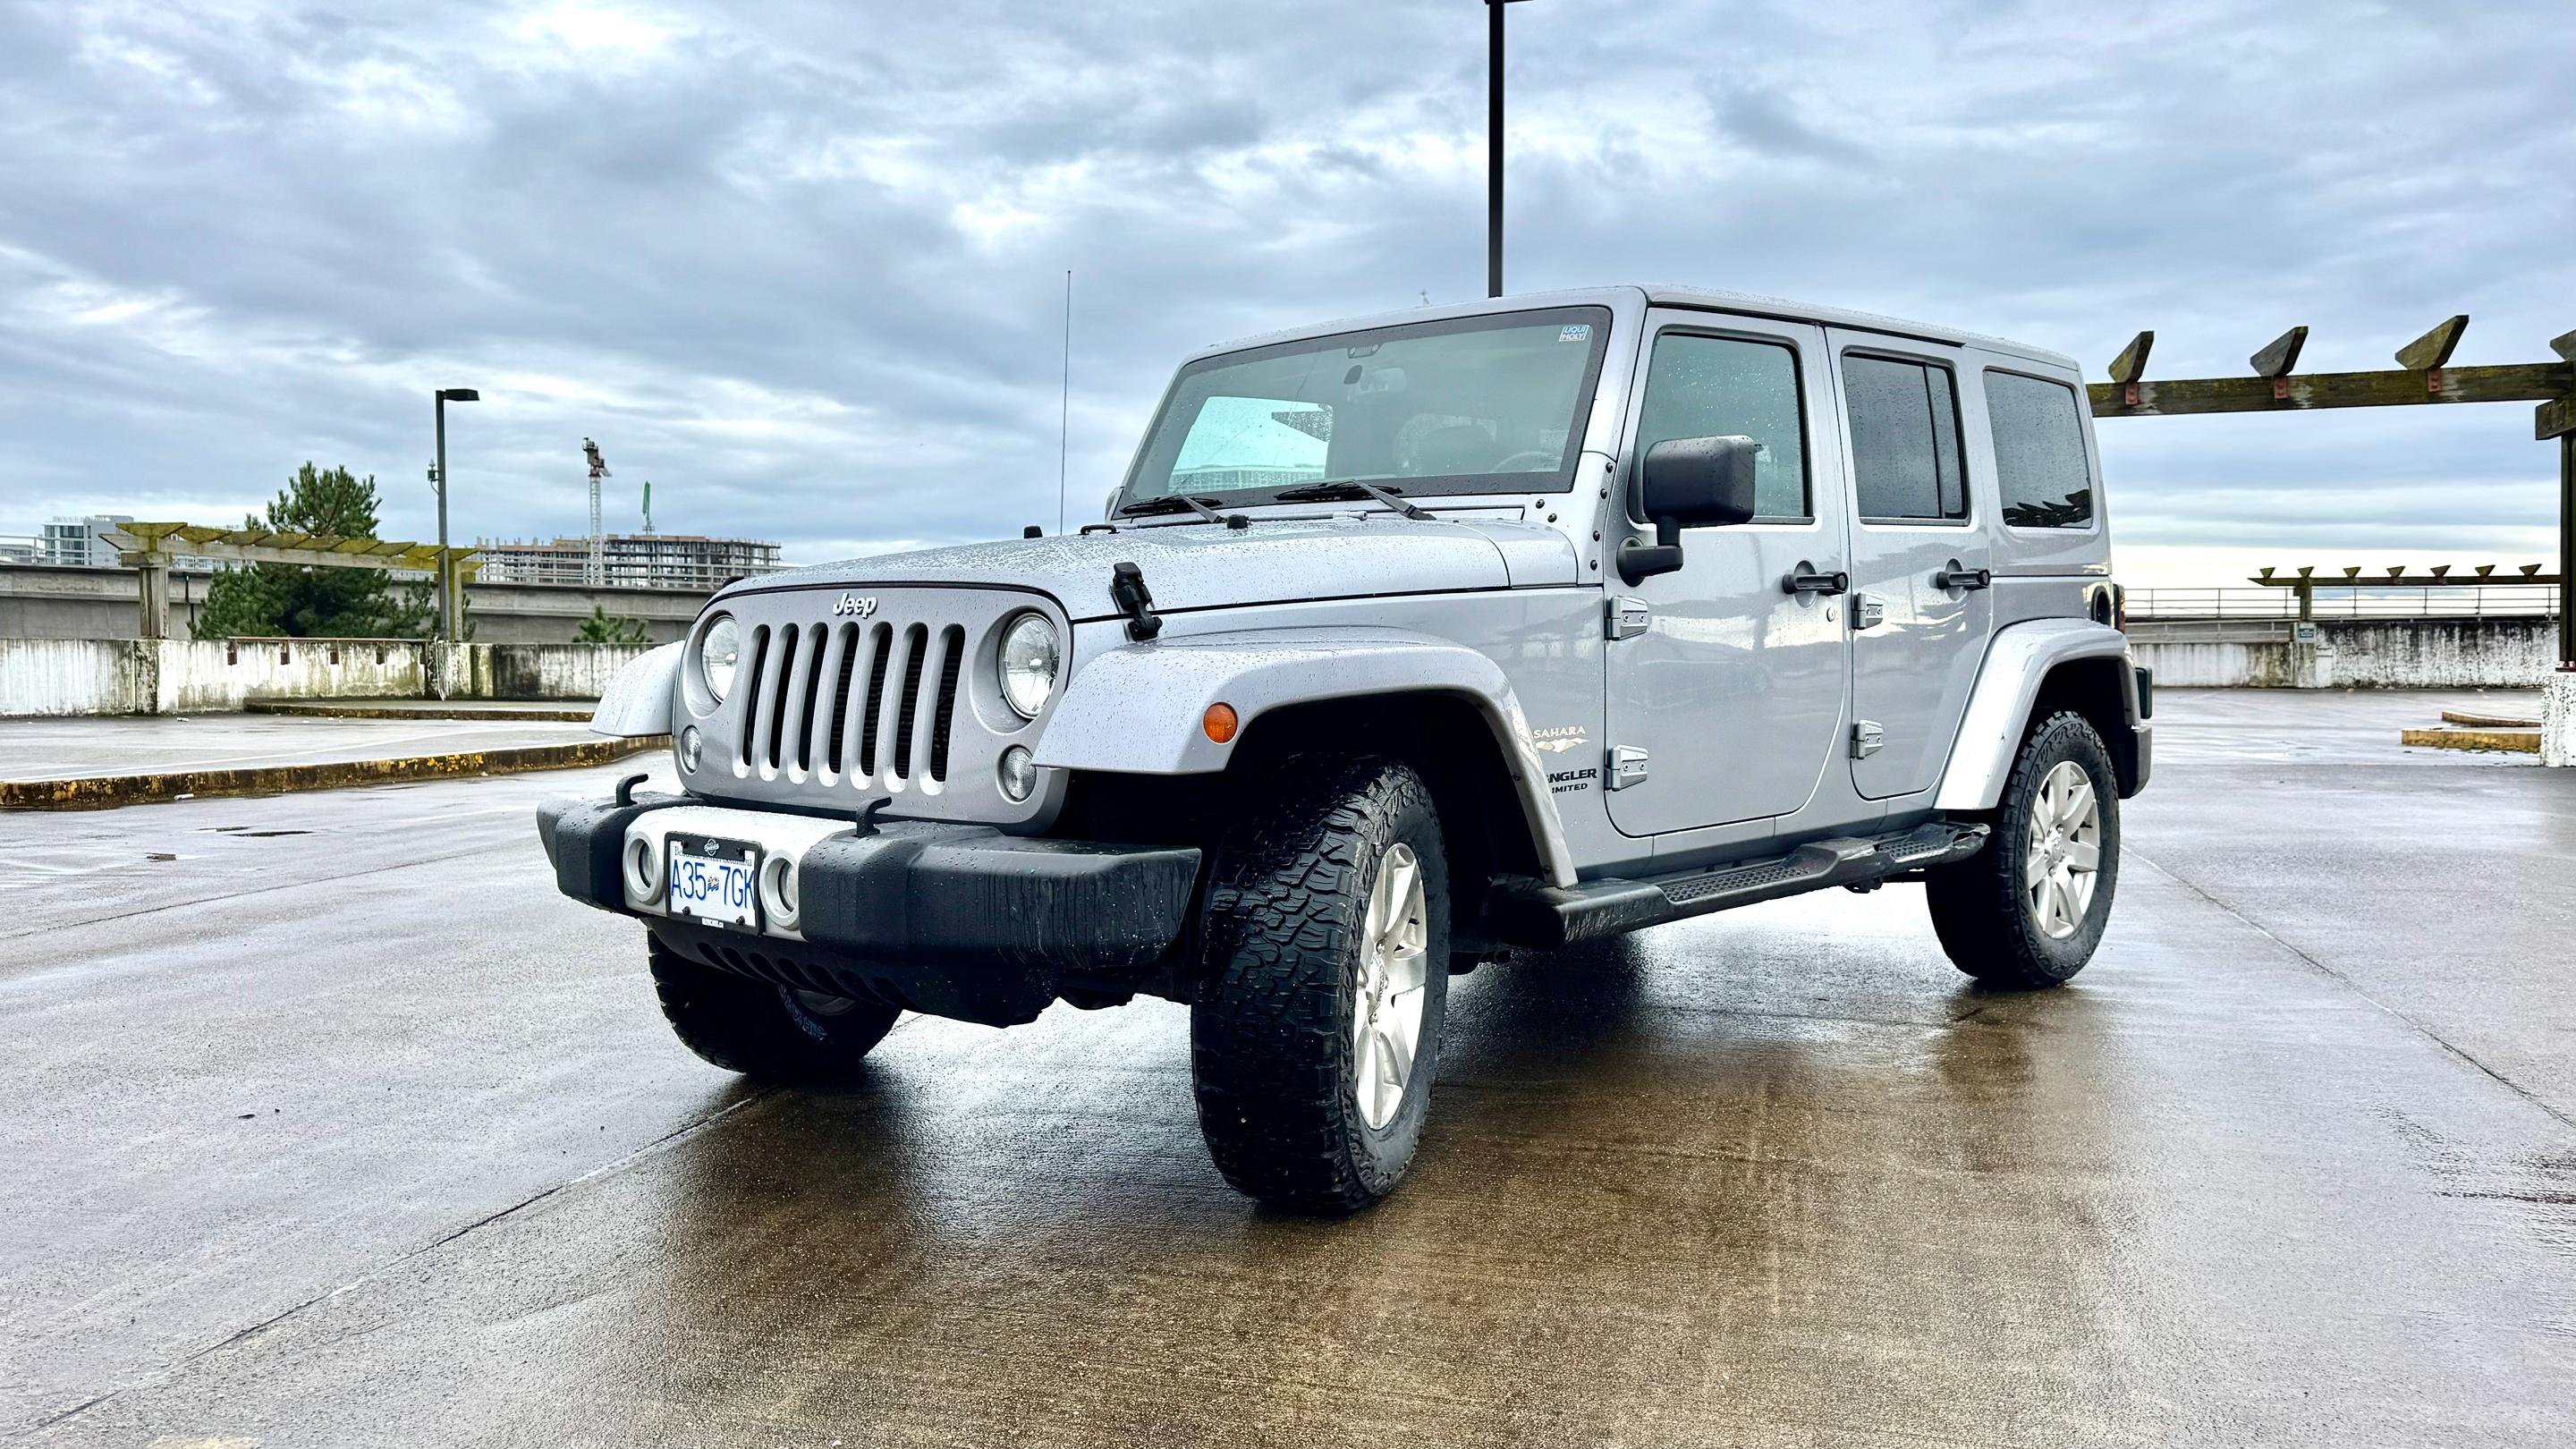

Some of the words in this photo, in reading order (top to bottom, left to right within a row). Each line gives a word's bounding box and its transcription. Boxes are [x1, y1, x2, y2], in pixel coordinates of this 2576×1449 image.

[833, 592, 877, 618] Jeep
[1533, 725, 1586, 739] SAHARA
[1546, 768, 1597, 784] NGLER
[1551, 783, 1589, 794] IMITED
[671, 860, 707, 901] A35
[719, 865, 756, 909] 7GK
